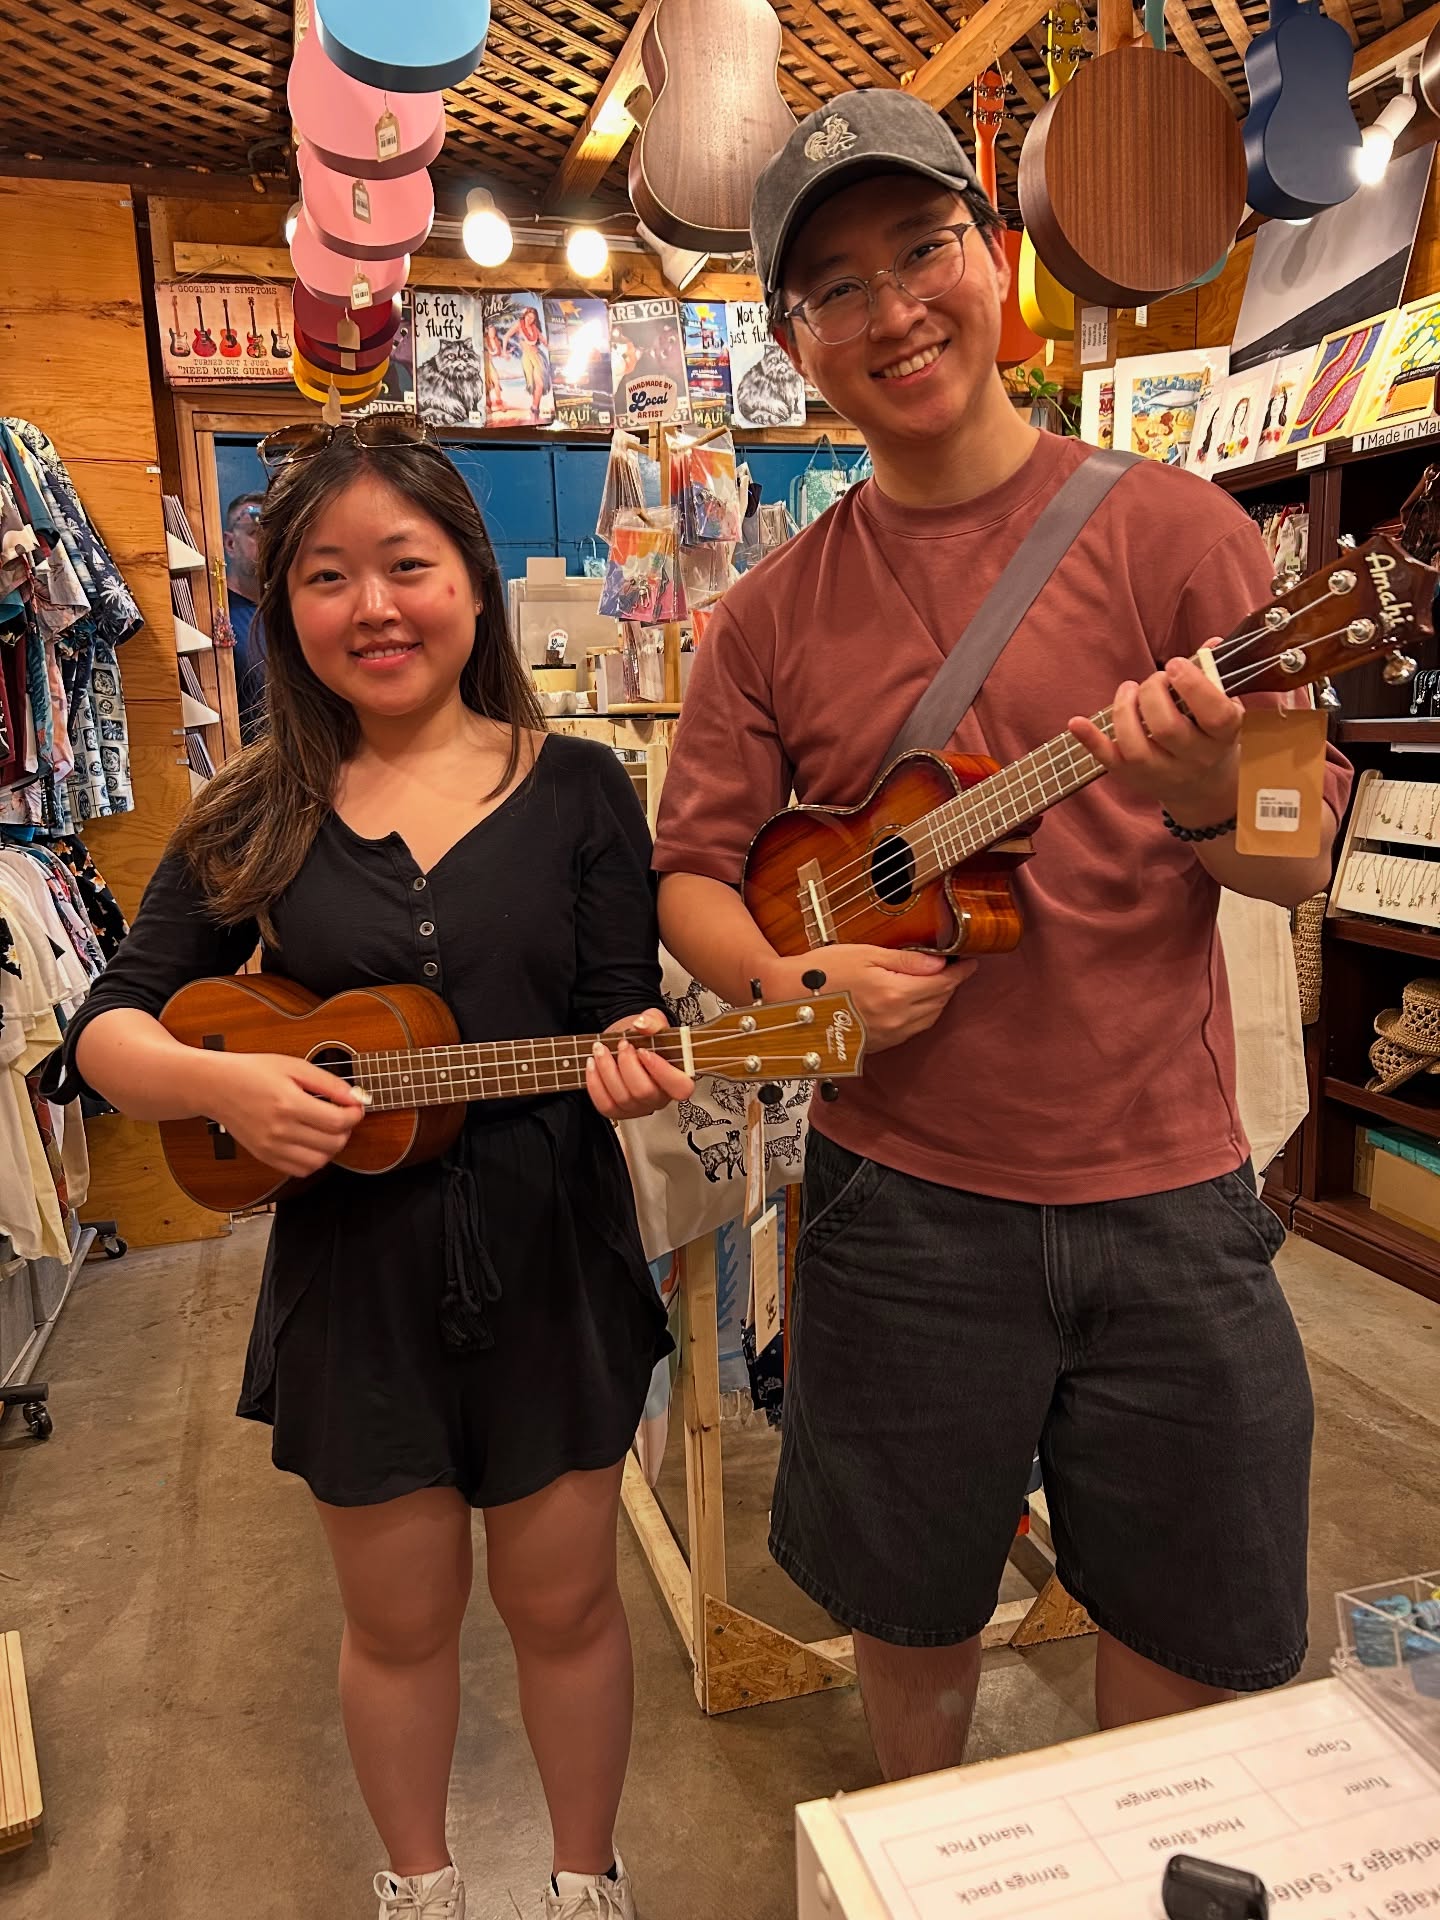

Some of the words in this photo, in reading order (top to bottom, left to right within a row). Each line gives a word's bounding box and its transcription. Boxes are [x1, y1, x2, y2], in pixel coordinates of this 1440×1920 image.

[416, 299, 429, 316] ot
[434, 297, 464, 322] fat,
[638, 300, 674, 318] YOU
[736, 305, 754, 327] Not
[425, 318, 462, 339] fluffy
[730, 331, 748, 348] just
[178, 365, 208, 374] "NEED
[213, 366, 238, 375] MORE
[243, 366, 287, 376] GUITARS"
[628, 380, 662, 394] HANDMADE
[664, 381, 673, 390] BY
[628, 390, 669, 413] Local
[558, 410, 590, 421] MAUI
[637, 409, 664, 419] ARTIST
[694, 411, 723, 423] MAUI
[1368, 429, 1400, 448] Made
[1404, 425, 1414, 439] in
[1364, 552, 1414, 628] Amahi
[832, 1008, 853, 1062] Ohana
[1306, 1738, 1352, 1758] Capo
[1171, 1776, 1216, 1796] Wall
[1344, 1775, 1392, 1796] Tuner
[1115, 1785, 1175, 1810] hanger
[978, 1823, 1034, 1848] Island
[1194, 1816, 1246, 1839] Hook
[936, 1837, 978, 1857] Pick
[1148, 1829, 1198, 1851] Strap
[1361, 1837, 1440, 1872] ackage
[1005, 1863, 1070, 1890] Strings
[956, 1879, 1003, 1905] pack
[1384, 1882, 1440, 1916] kage
